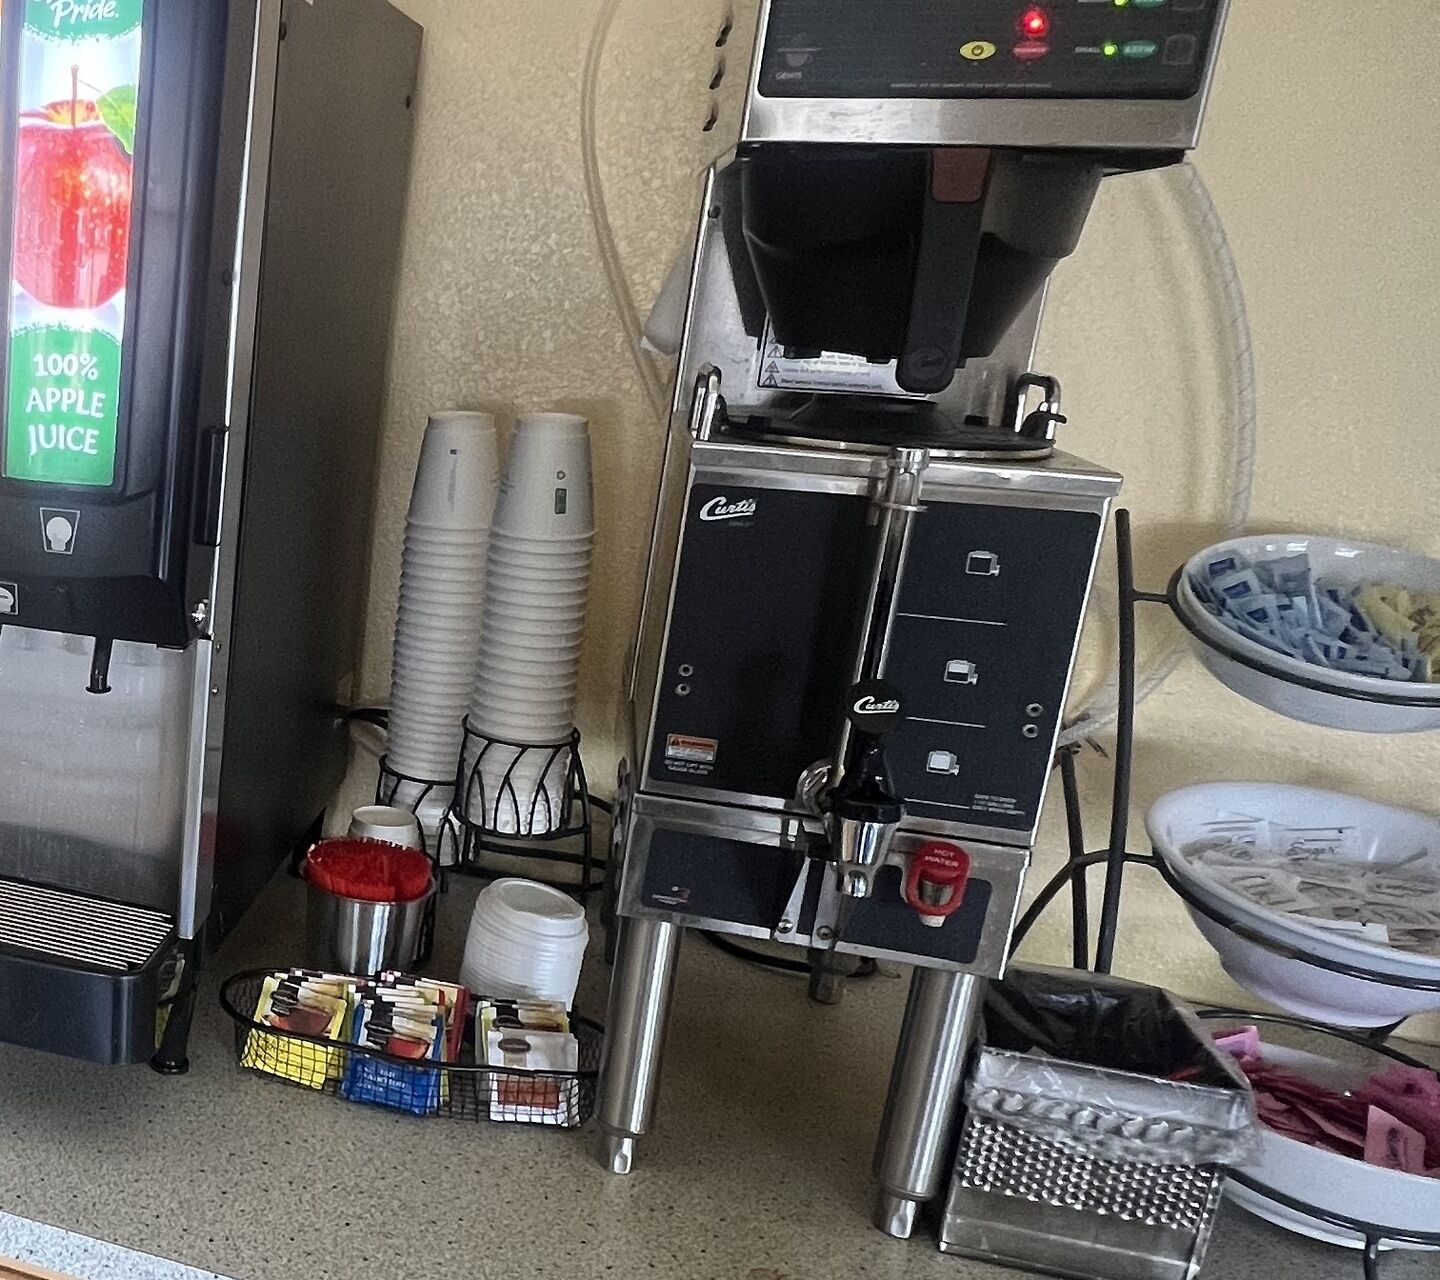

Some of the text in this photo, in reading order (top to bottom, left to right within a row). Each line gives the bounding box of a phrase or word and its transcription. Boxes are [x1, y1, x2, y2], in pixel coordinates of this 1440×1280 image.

[32, 352, 99, 381] 100%
[25, 387, 107, 419] APPLE
[28, 424, 100, 456] JUICE
[699, 496, 756, 521] Curtis
[853, 695, 900, 714] Curtis
